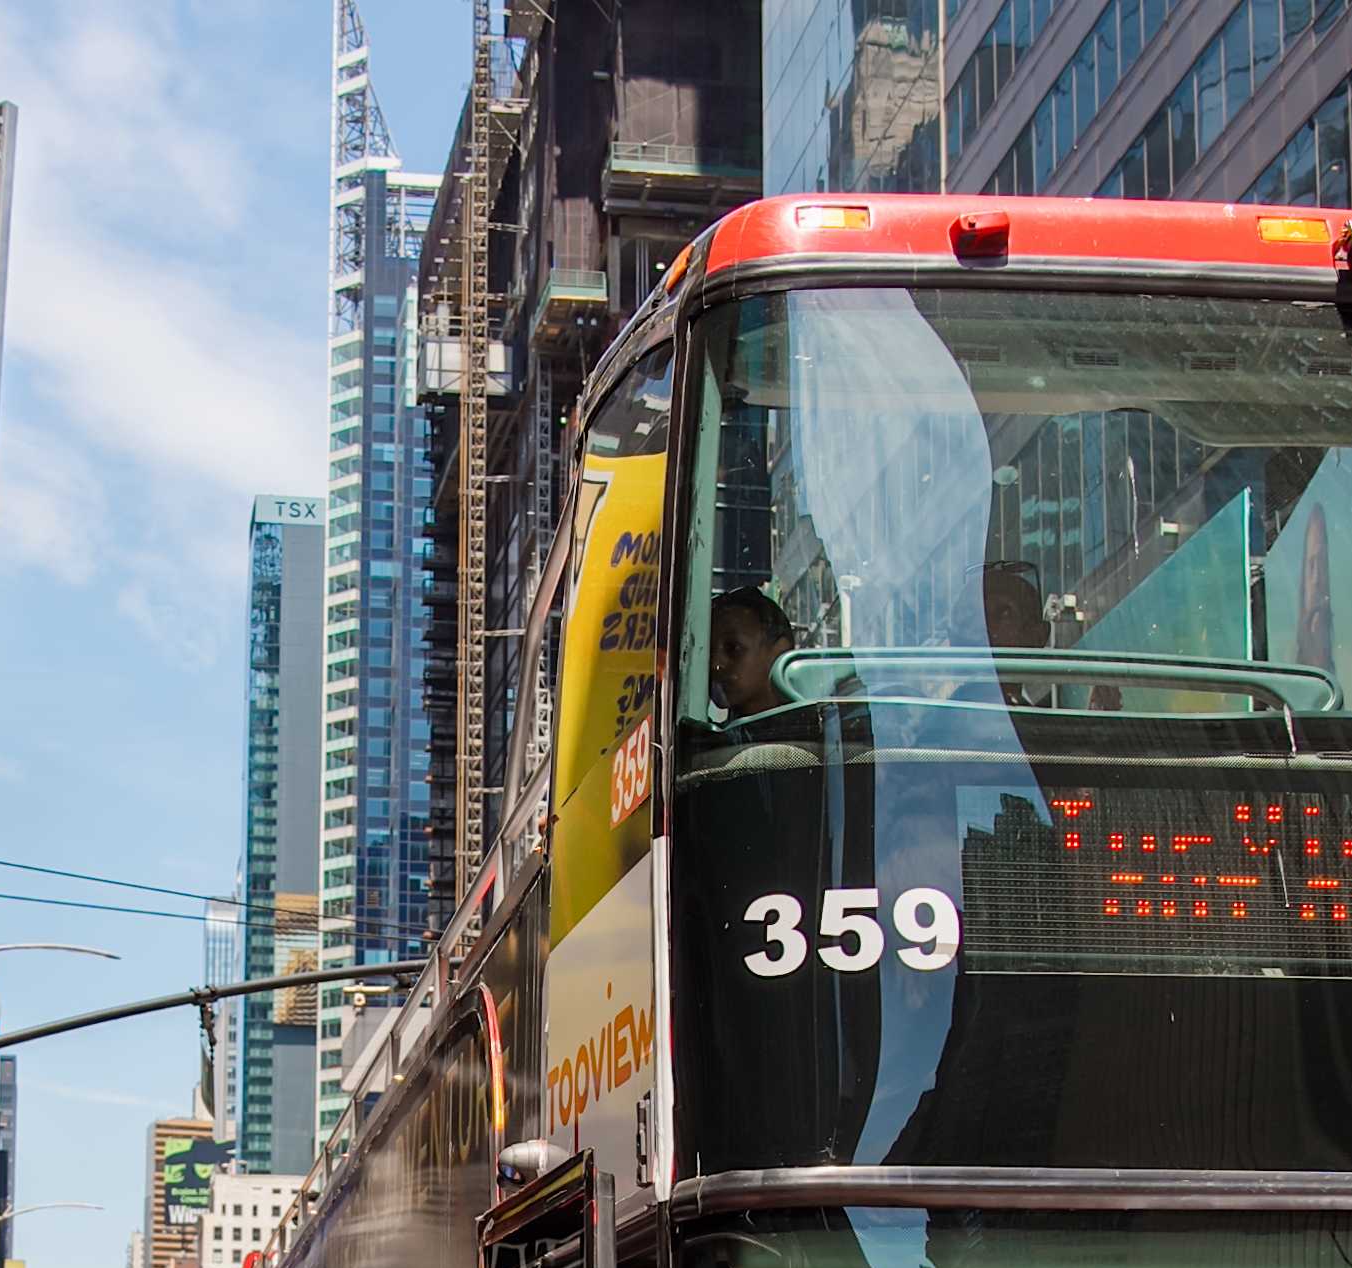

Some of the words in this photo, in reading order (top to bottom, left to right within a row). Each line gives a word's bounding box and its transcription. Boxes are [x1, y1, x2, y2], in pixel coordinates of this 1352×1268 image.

[275, 501, 317, 520] TSX
[611, 716, 649, 827] 359
[743, 887, 961, 978] 359
